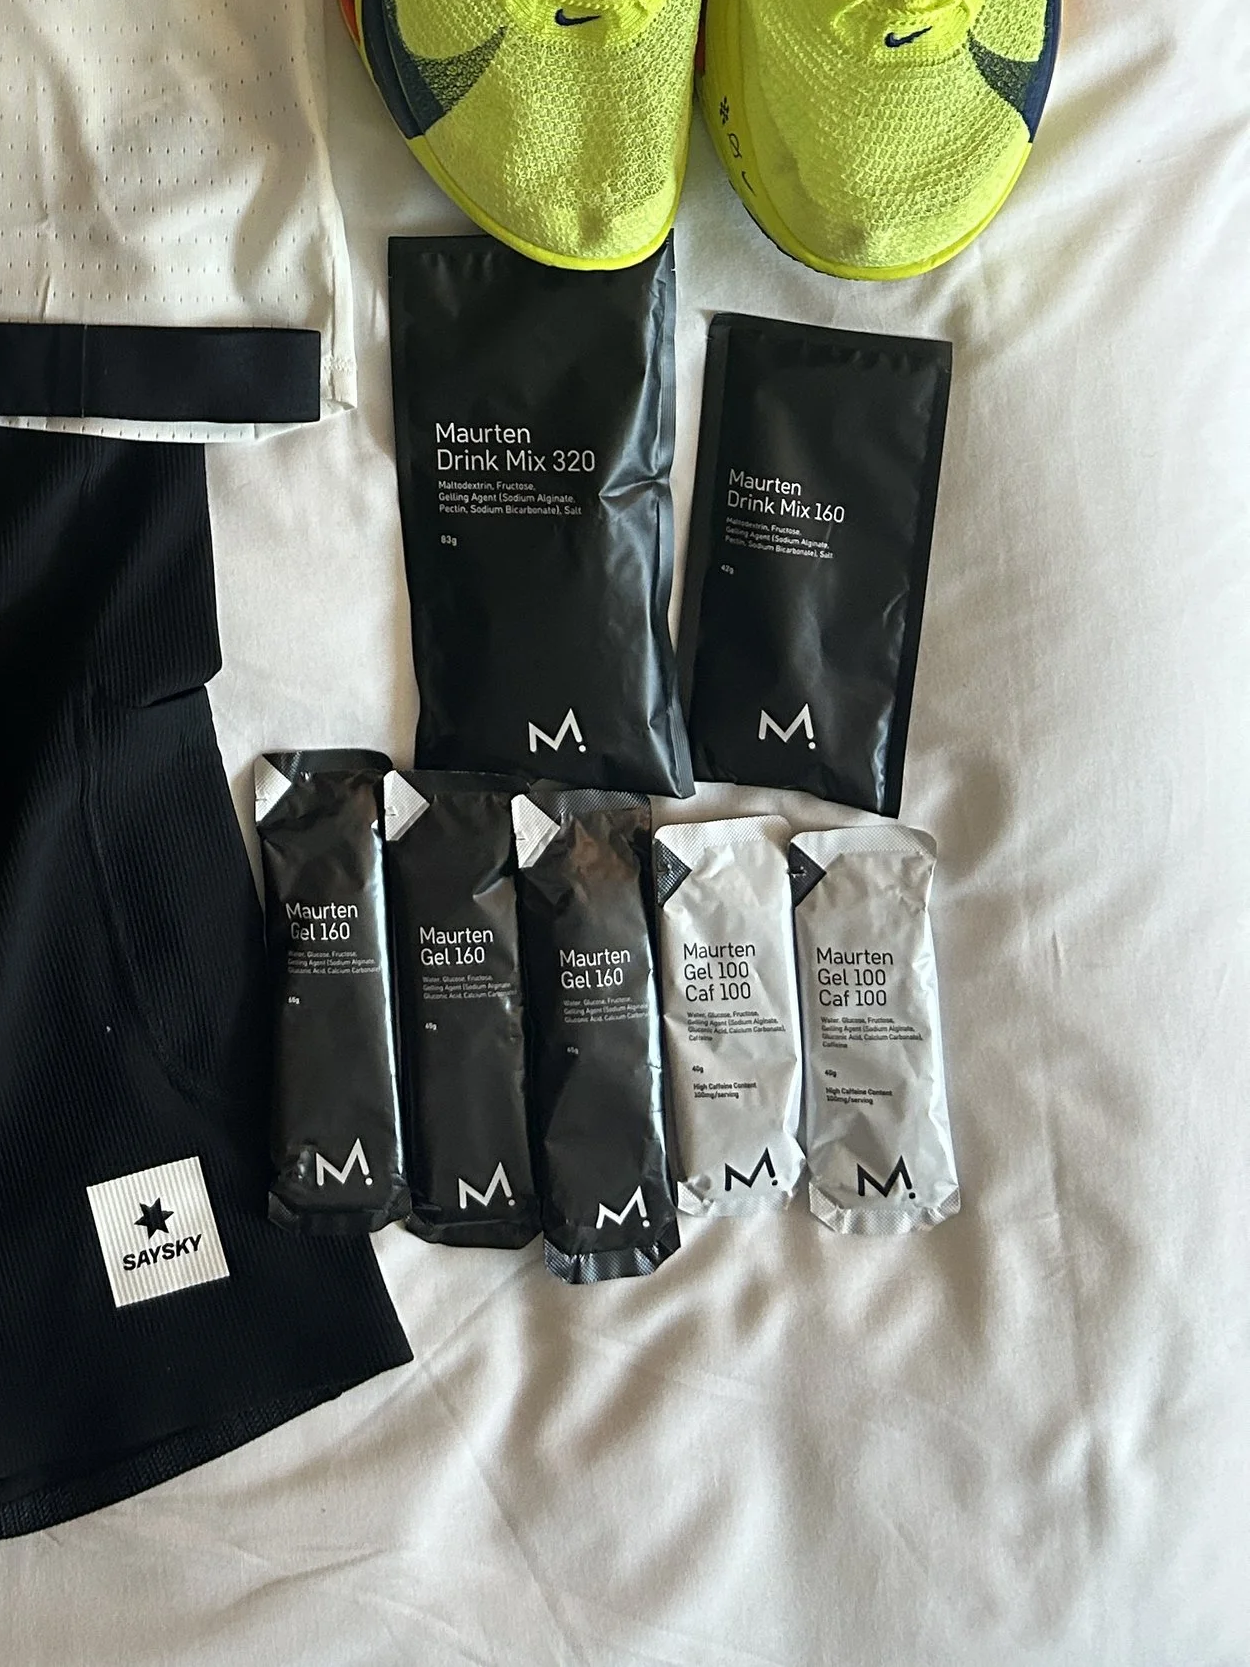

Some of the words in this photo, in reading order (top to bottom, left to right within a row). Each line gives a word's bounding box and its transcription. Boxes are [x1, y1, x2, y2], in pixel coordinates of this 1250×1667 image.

[435, 422, 531, 443] Maurten
[437, 449, 499, 471] Drink
[506, 450, 546, 472] Mix
[552, 450, 595, 472] 320
[438, 481, 494, 490] Maltodextrin,
[729, 468, 801, 496] Maurten
[439, 492, 469, 504] Gelling
[471, 493, 496, 504] Agent
[499, 493, 534, 502] (Sodium
[727, 490, 775, 515] Drink
[780, 498, 810, 519] Mix
[814, 502, 845, 523] 160
[439, 504, 468, 514] Pectin,
[470, 505, 503, 514] Sodium
[564, 506, 582, 514] Salt
[771, 525, 802, 535] Fructose,
[441, 535, 457, 546] 83g
[286, 902, 358, 919] Maurten
[291, 922, 315, 941] Gel
[320, 922, 350, 940] 160
[420, 926, 494, 944] Maurten
[421, 948, 450, 965] Gel
[455, 947, 485, 965] 160
[559, 949, 631, 967] Maurten
[684, 942, 755, 960] Maurten
[817, 947, 893, 965] Maurten
[561, 970, 591, 989] Gel
[595, 967, 623, 987] 160
[684, 962, 713, 980] Gel
[718, 961, 749, 978] 100
[818, 968, 849, 986] Gel
[854, 969, 886, 986] 100
[685, 984, 714, 1002] Caf
[720, 982, 751, 1000] 100
[819, 989, 849, 1006] Caf
[855, 990, 887, 1006] 100
[694, 1083, 707, 1091] High
[826, 1087, 840, 1095] High
[868, 1088, 893, 1096] Content
[123, 1234, 202, 1271] SAYSKY
